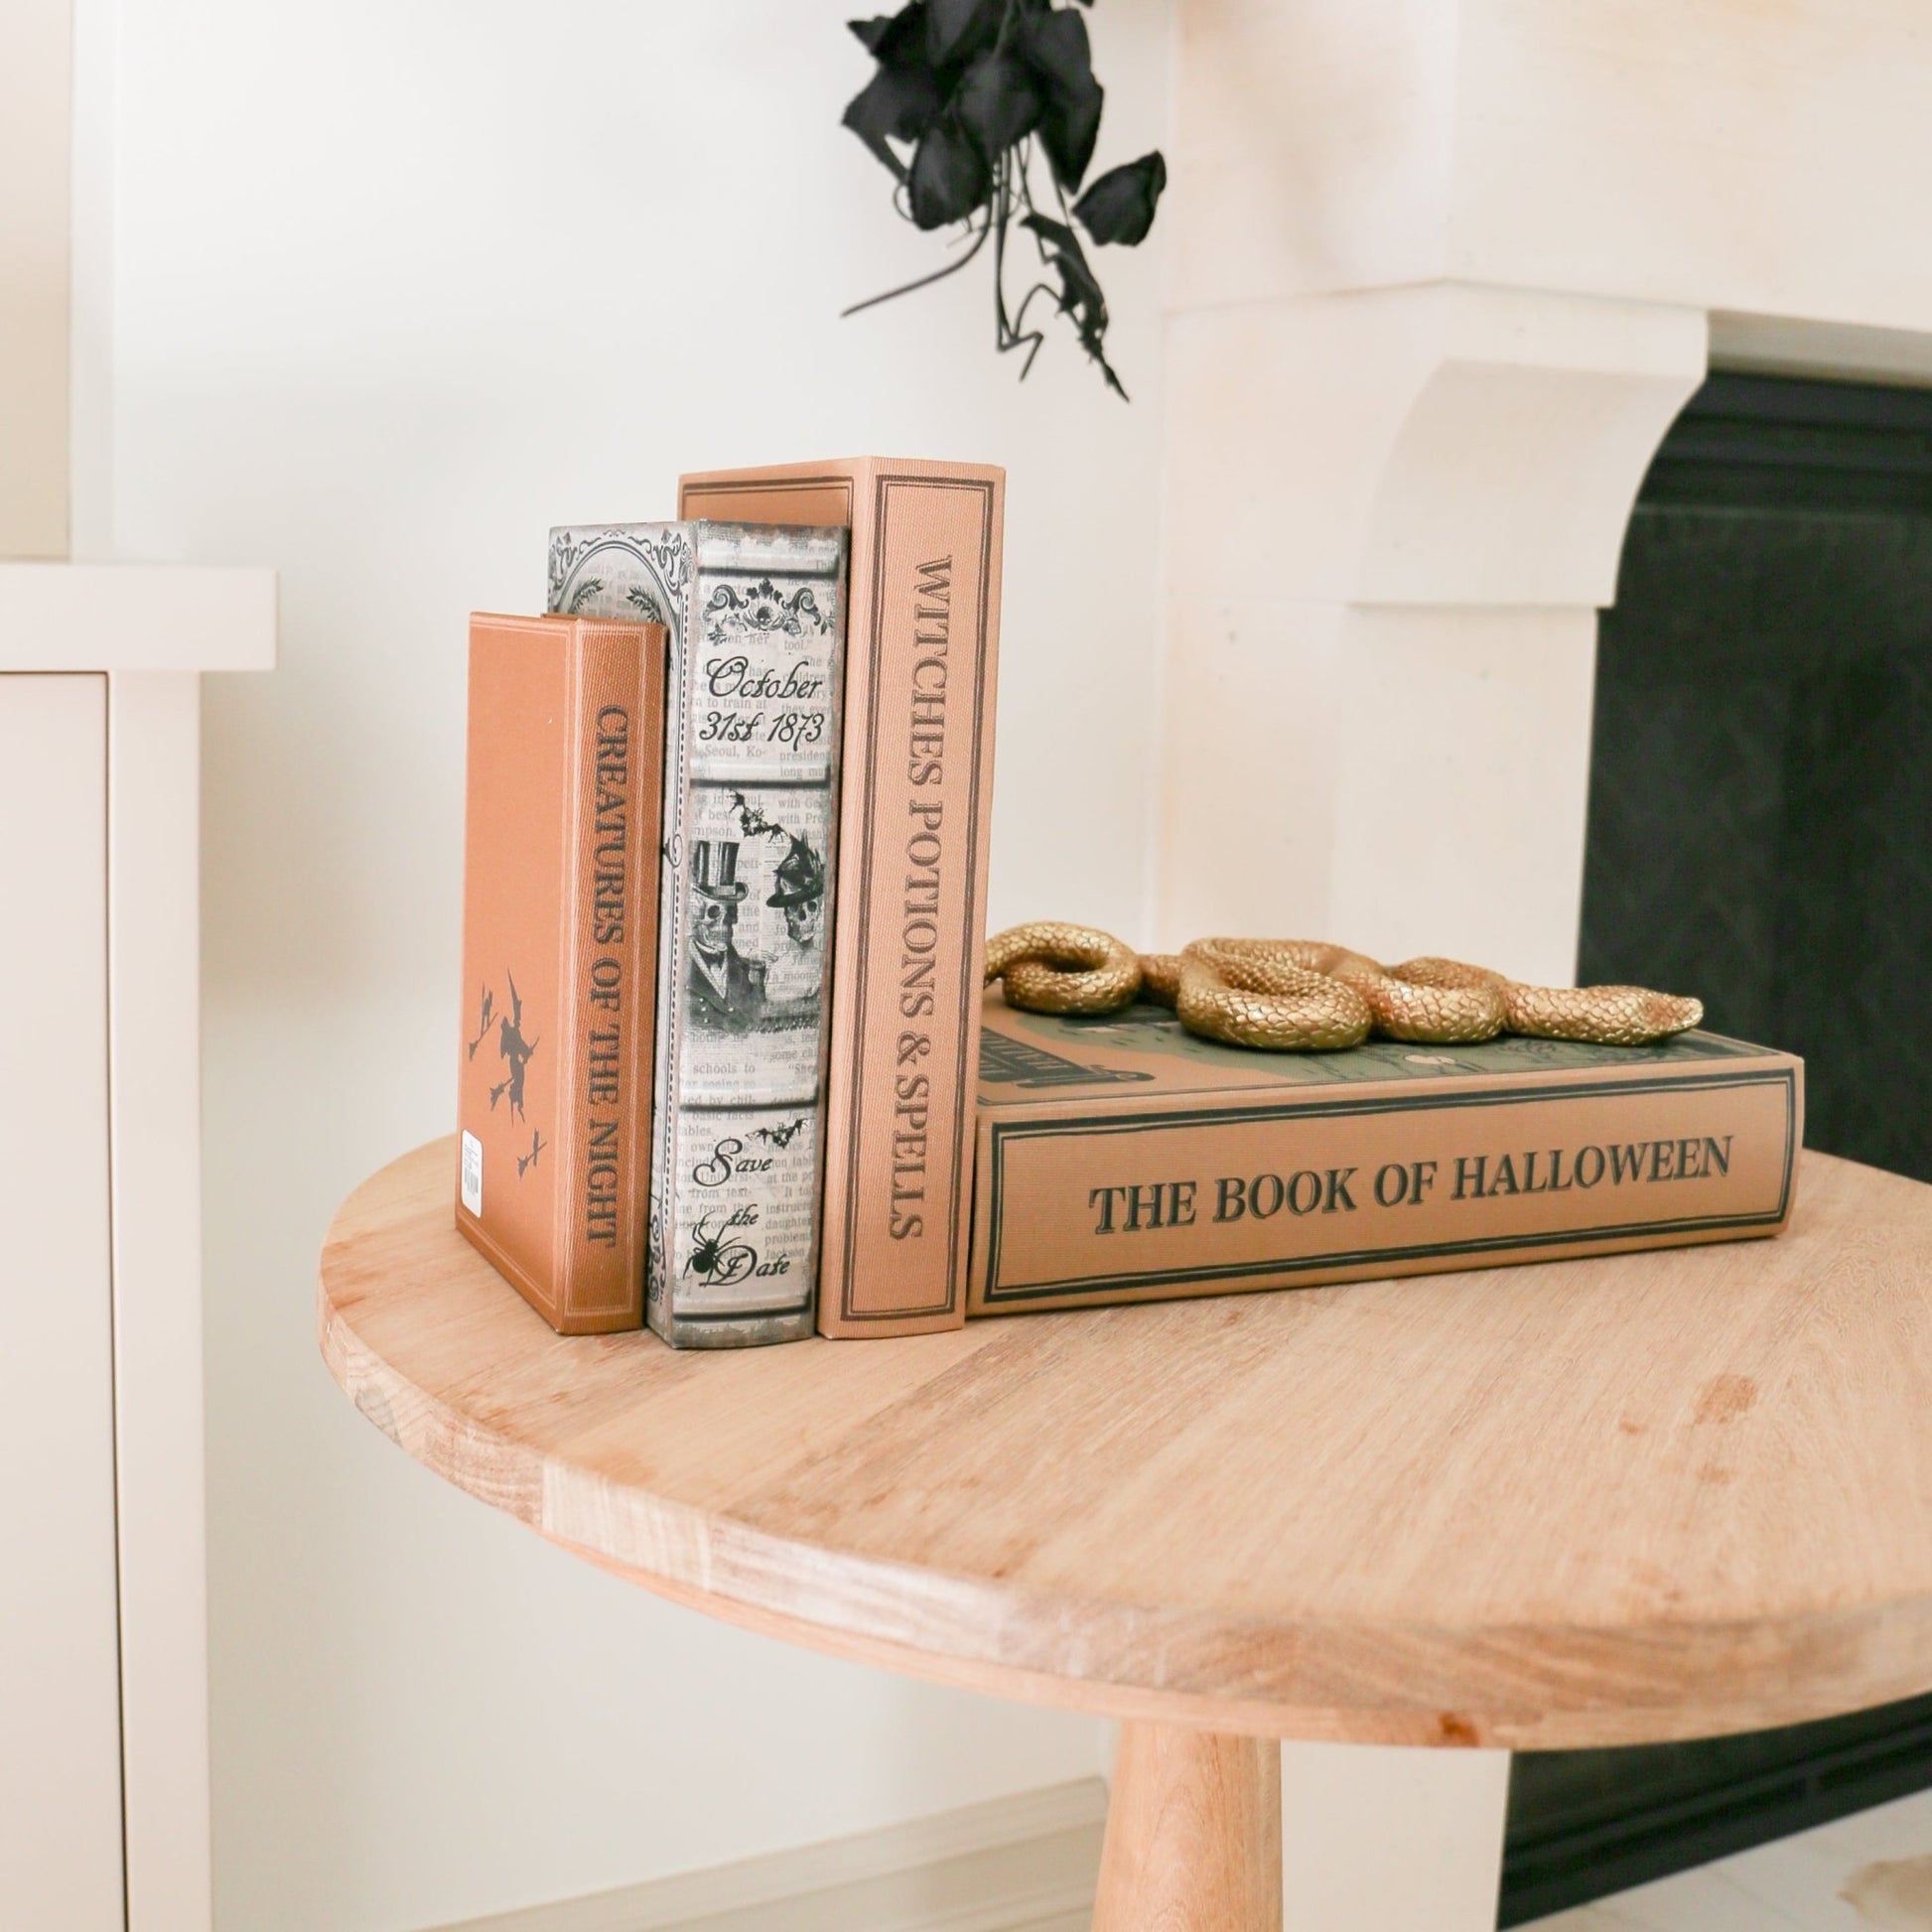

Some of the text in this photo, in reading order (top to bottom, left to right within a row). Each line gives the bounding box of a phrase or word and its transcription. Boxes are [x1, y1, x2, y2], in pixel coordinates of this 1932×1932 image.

[706, 655, 823, 699] October
[699, 711, 825, 752] 31st 1873
[706, 746, 740, 759] Seoul,
[778, 795, 800, 808] with
[778, 811, 800, 824] with
[890, 554, 952, 1241] WITCHES POTIONS & SPELLS
[587, 704, 628, 1249] CREATURES OF THE NIGHT
[693, 1062, 756, 1074] schools to
[693, 1139, 772, 1187] Save
[1088, 1135, 1734, 1235] THE BOOK OF HALLOWEEN
[727, 1203, 759, 1226] the
[699, 1244, 790, 1288] Date
